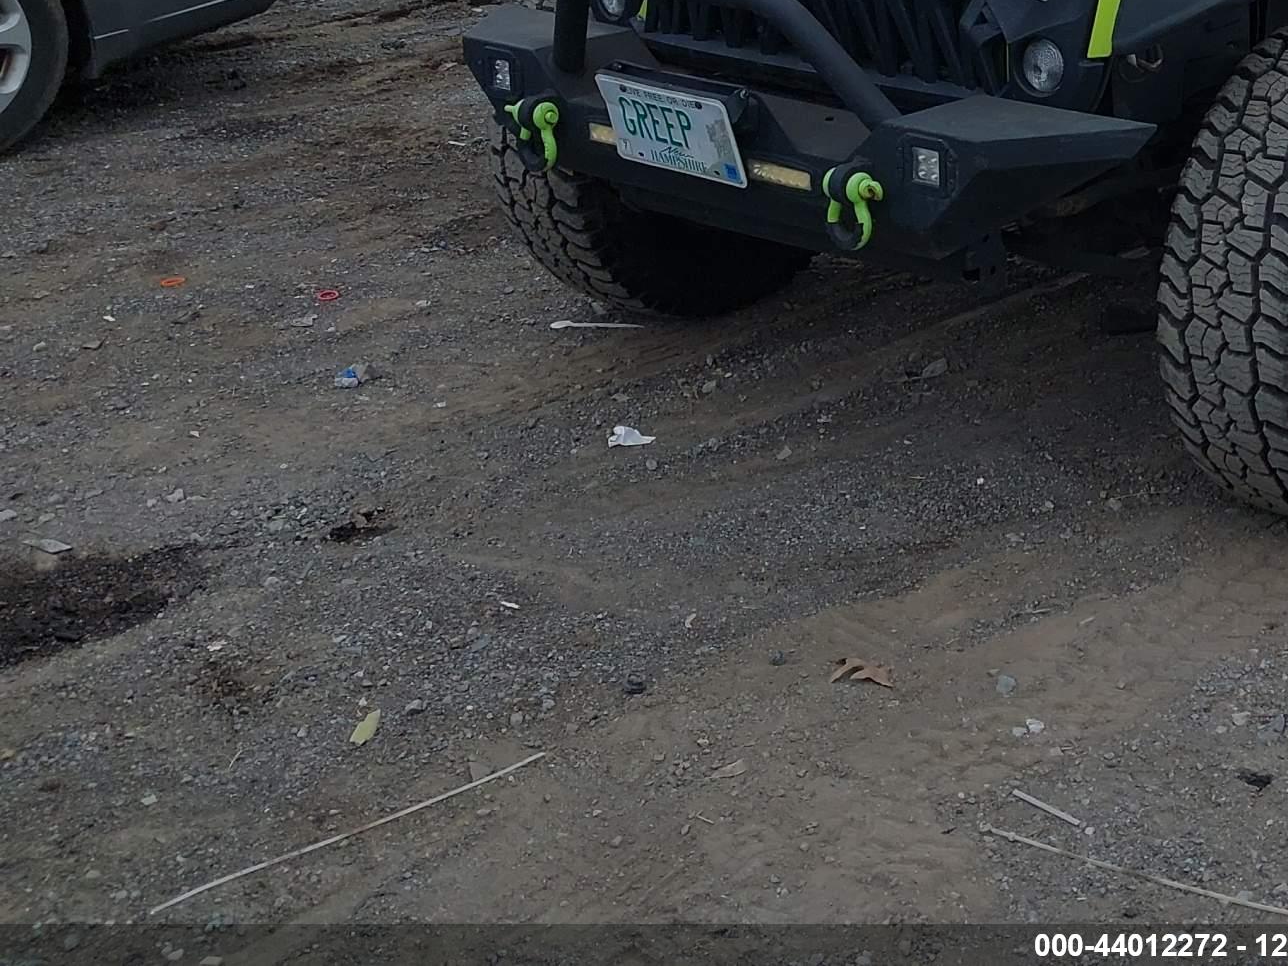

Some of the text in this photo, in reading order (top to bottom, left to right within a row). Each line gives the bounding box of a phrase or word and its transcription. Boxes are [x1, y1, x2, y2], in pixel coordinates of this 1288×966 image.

[643, 90, 664, 103] FREE
[666, 95, 679, 105] OR
[681, 98, 697, 108] DIE
[618, 96, 692, 150] GREEP
[651, 149, 707, 174] HAMPSHIRE
[660, 145, 694, 159] New
